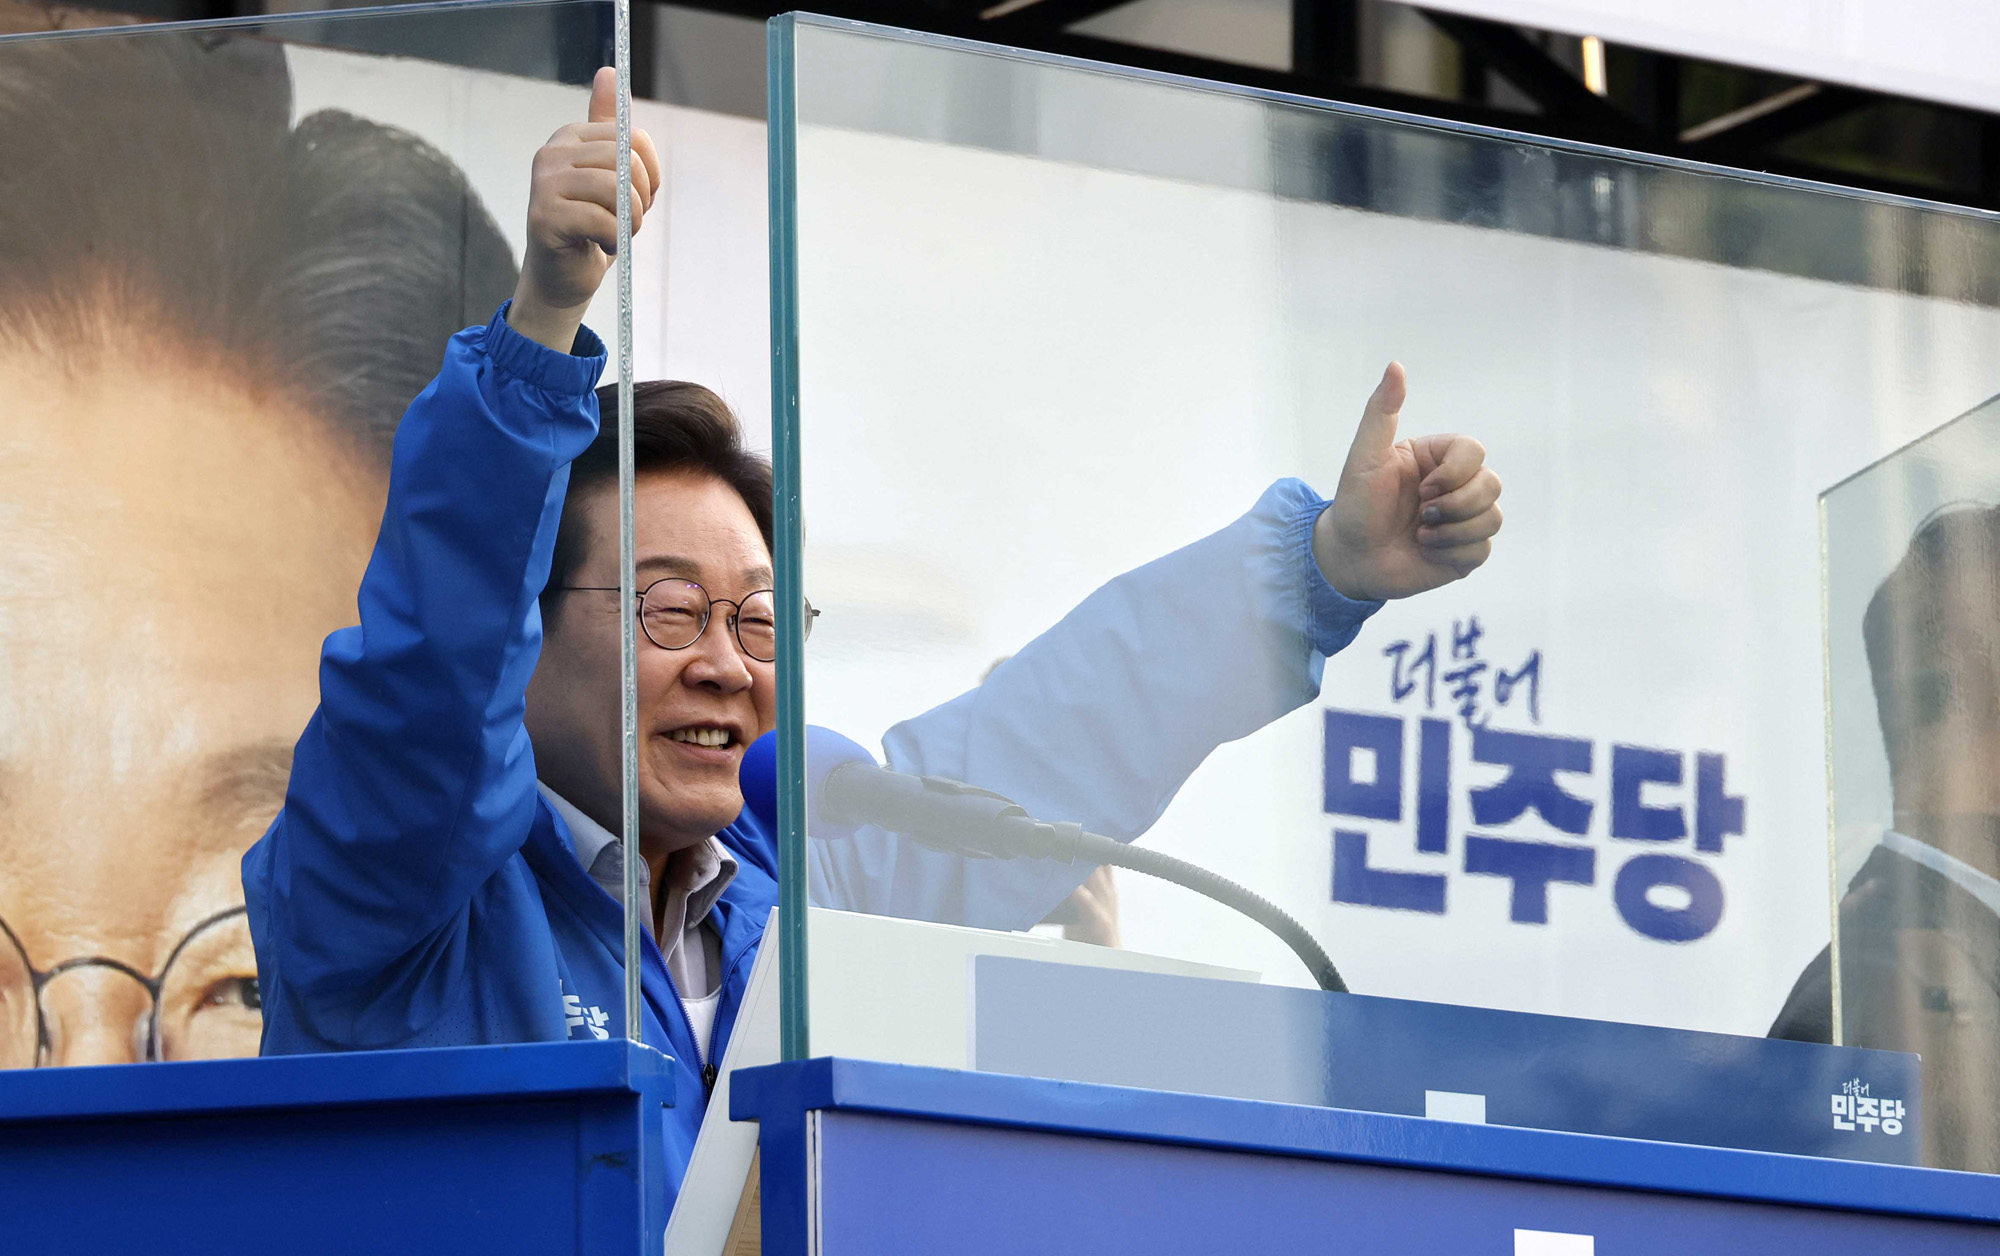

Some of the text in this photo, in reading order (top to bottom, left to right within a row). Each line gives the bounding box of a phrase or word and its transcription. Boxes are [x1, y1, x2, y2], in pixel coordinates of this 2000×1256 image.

[1383, 615, 1543, 729] 더불어
[1322, 708, 1747, 945] 민주당
[1831, 1094, 1906, 1136] 민주당
[1841, 1077, 1870, 1097] 더불어
